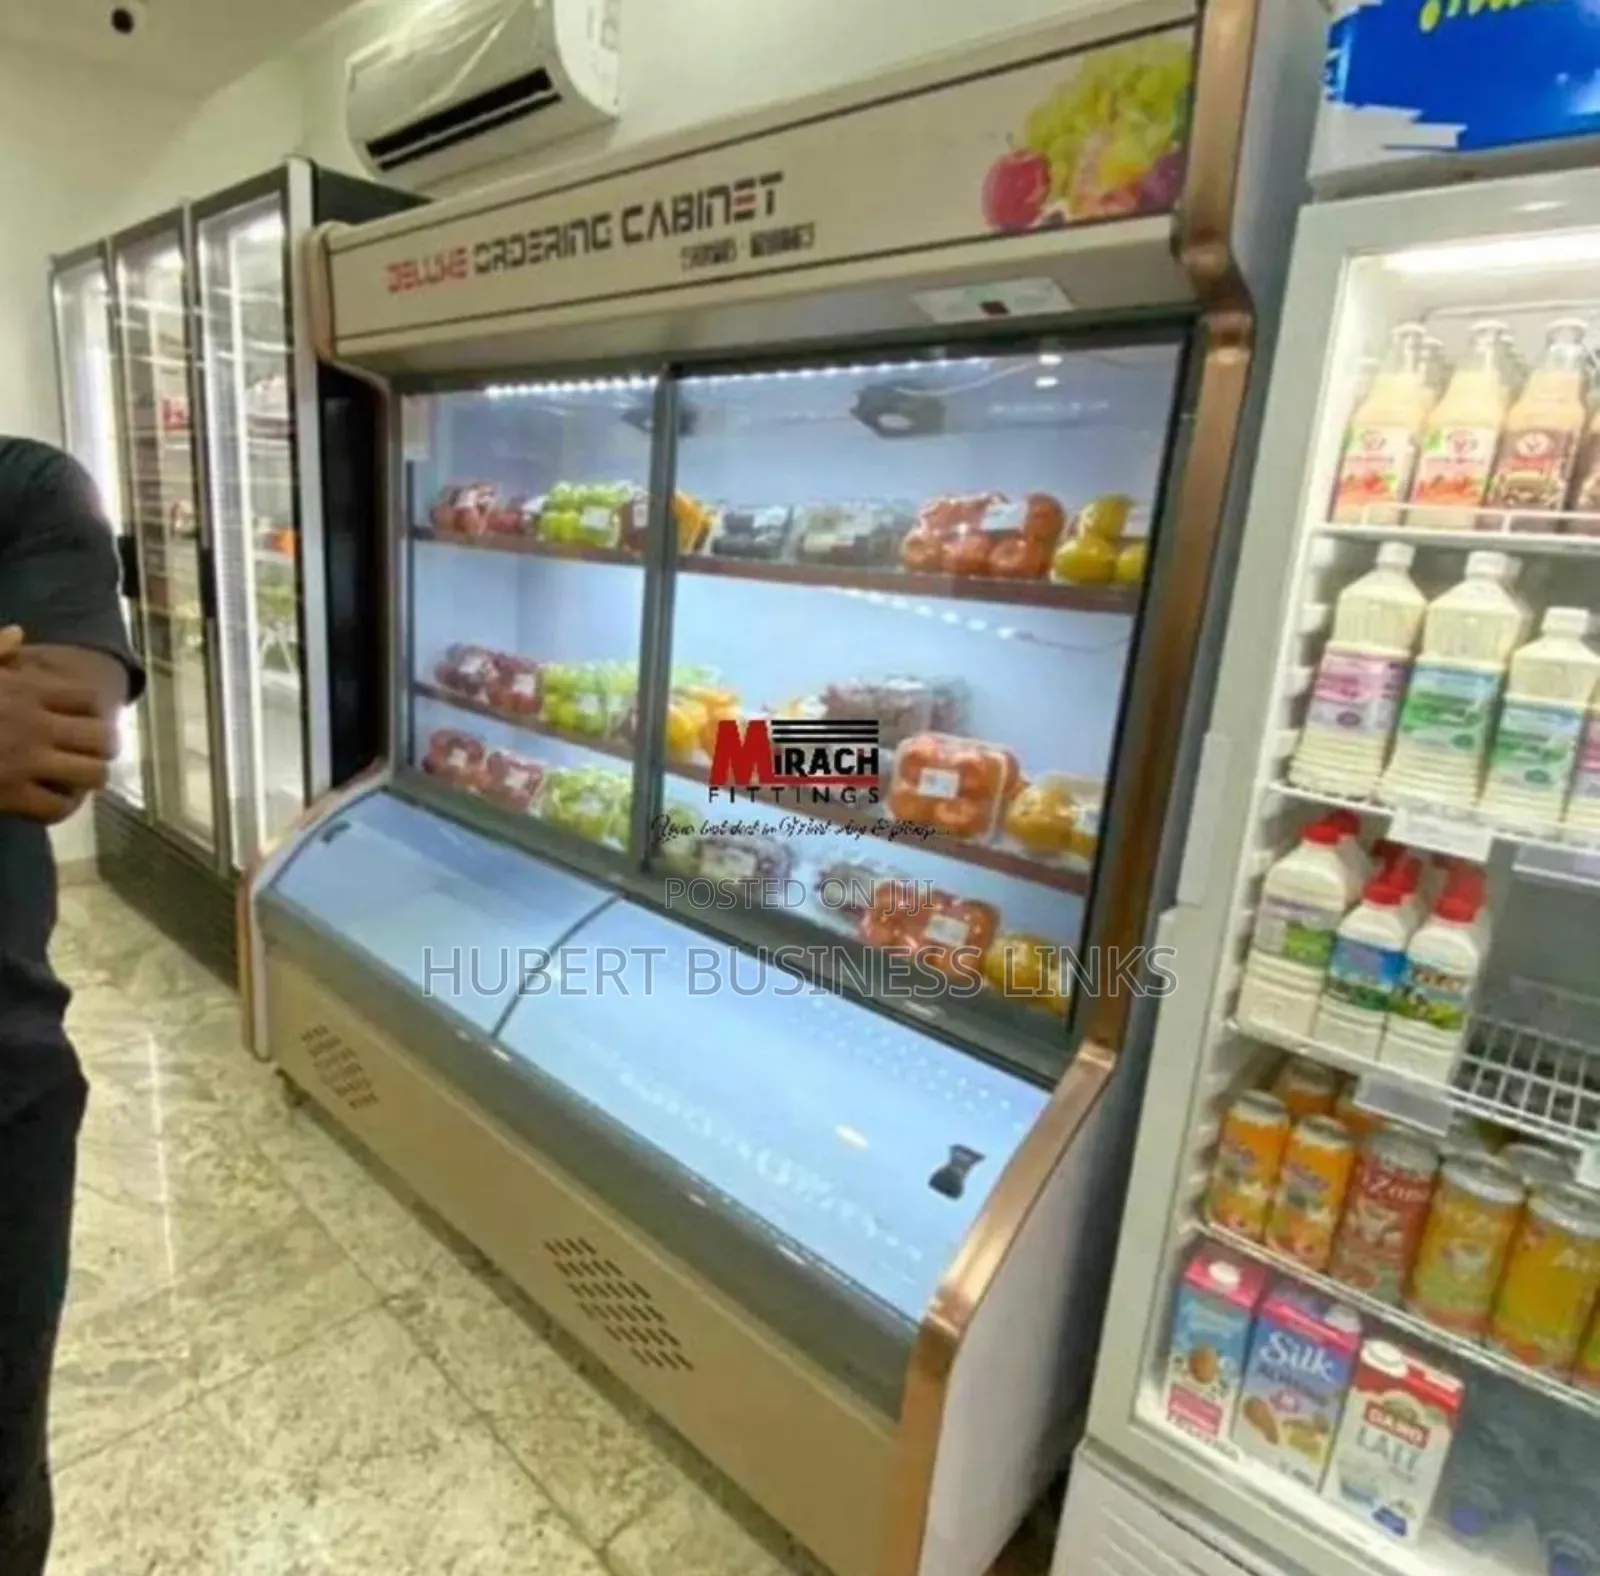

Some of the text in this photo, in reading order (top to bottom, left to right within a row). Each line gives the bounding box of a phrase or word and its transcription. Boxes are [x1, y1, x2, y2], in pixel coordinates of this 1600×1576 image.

[473, 213, 612, 275] ORDERING
[620, 170, 784, 245] CABINET
[1259, 1331, 1340, 1385] Silk
